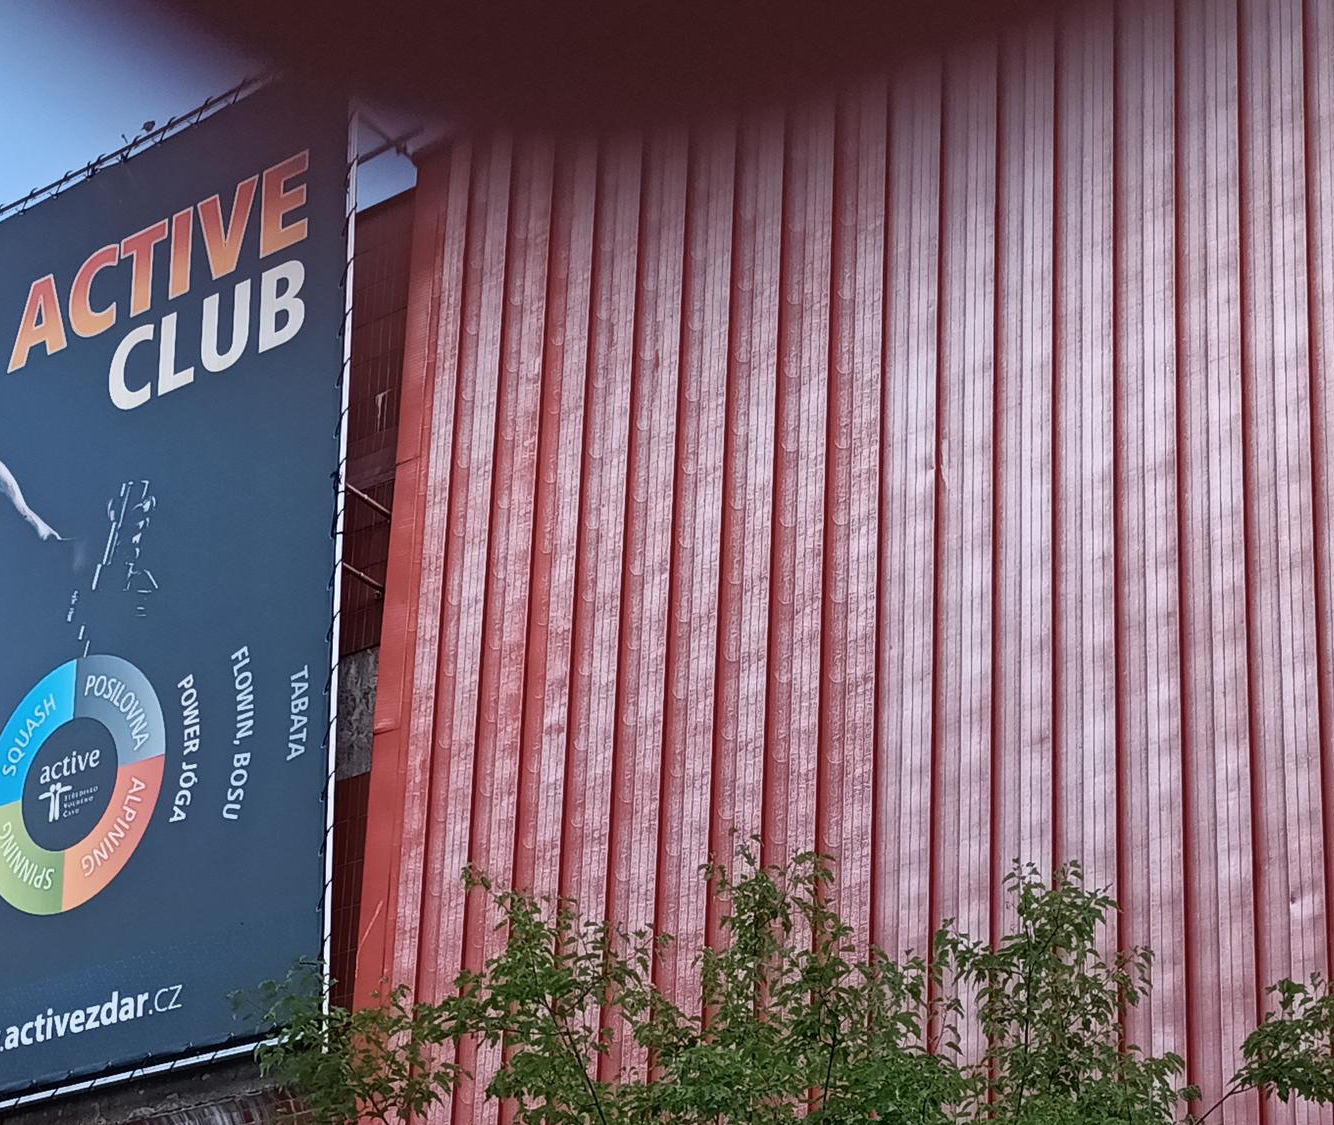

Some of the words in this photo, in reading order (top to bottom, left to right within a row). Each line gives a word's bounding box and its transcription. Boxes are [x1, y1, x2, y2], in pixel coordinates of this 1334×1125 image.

[7, 150, 309, 374] ACTIVE
[109, 260, 305, 410] CLUB
[2, 693, 57, 777] SQUASH
[85, 675, 150, 751] POSILOVNA
[177, 674, 200, 756] POWER
[231, 645, 254, 745] FLOWIN,
[286, 665, 309, 761] TABATA
[39, 749, 100, 784] active
[169, 761, 198, 822] JÓGA
[222, 752, 251, 820] BOSU
[81, 776, 147, 877] ALPINING
